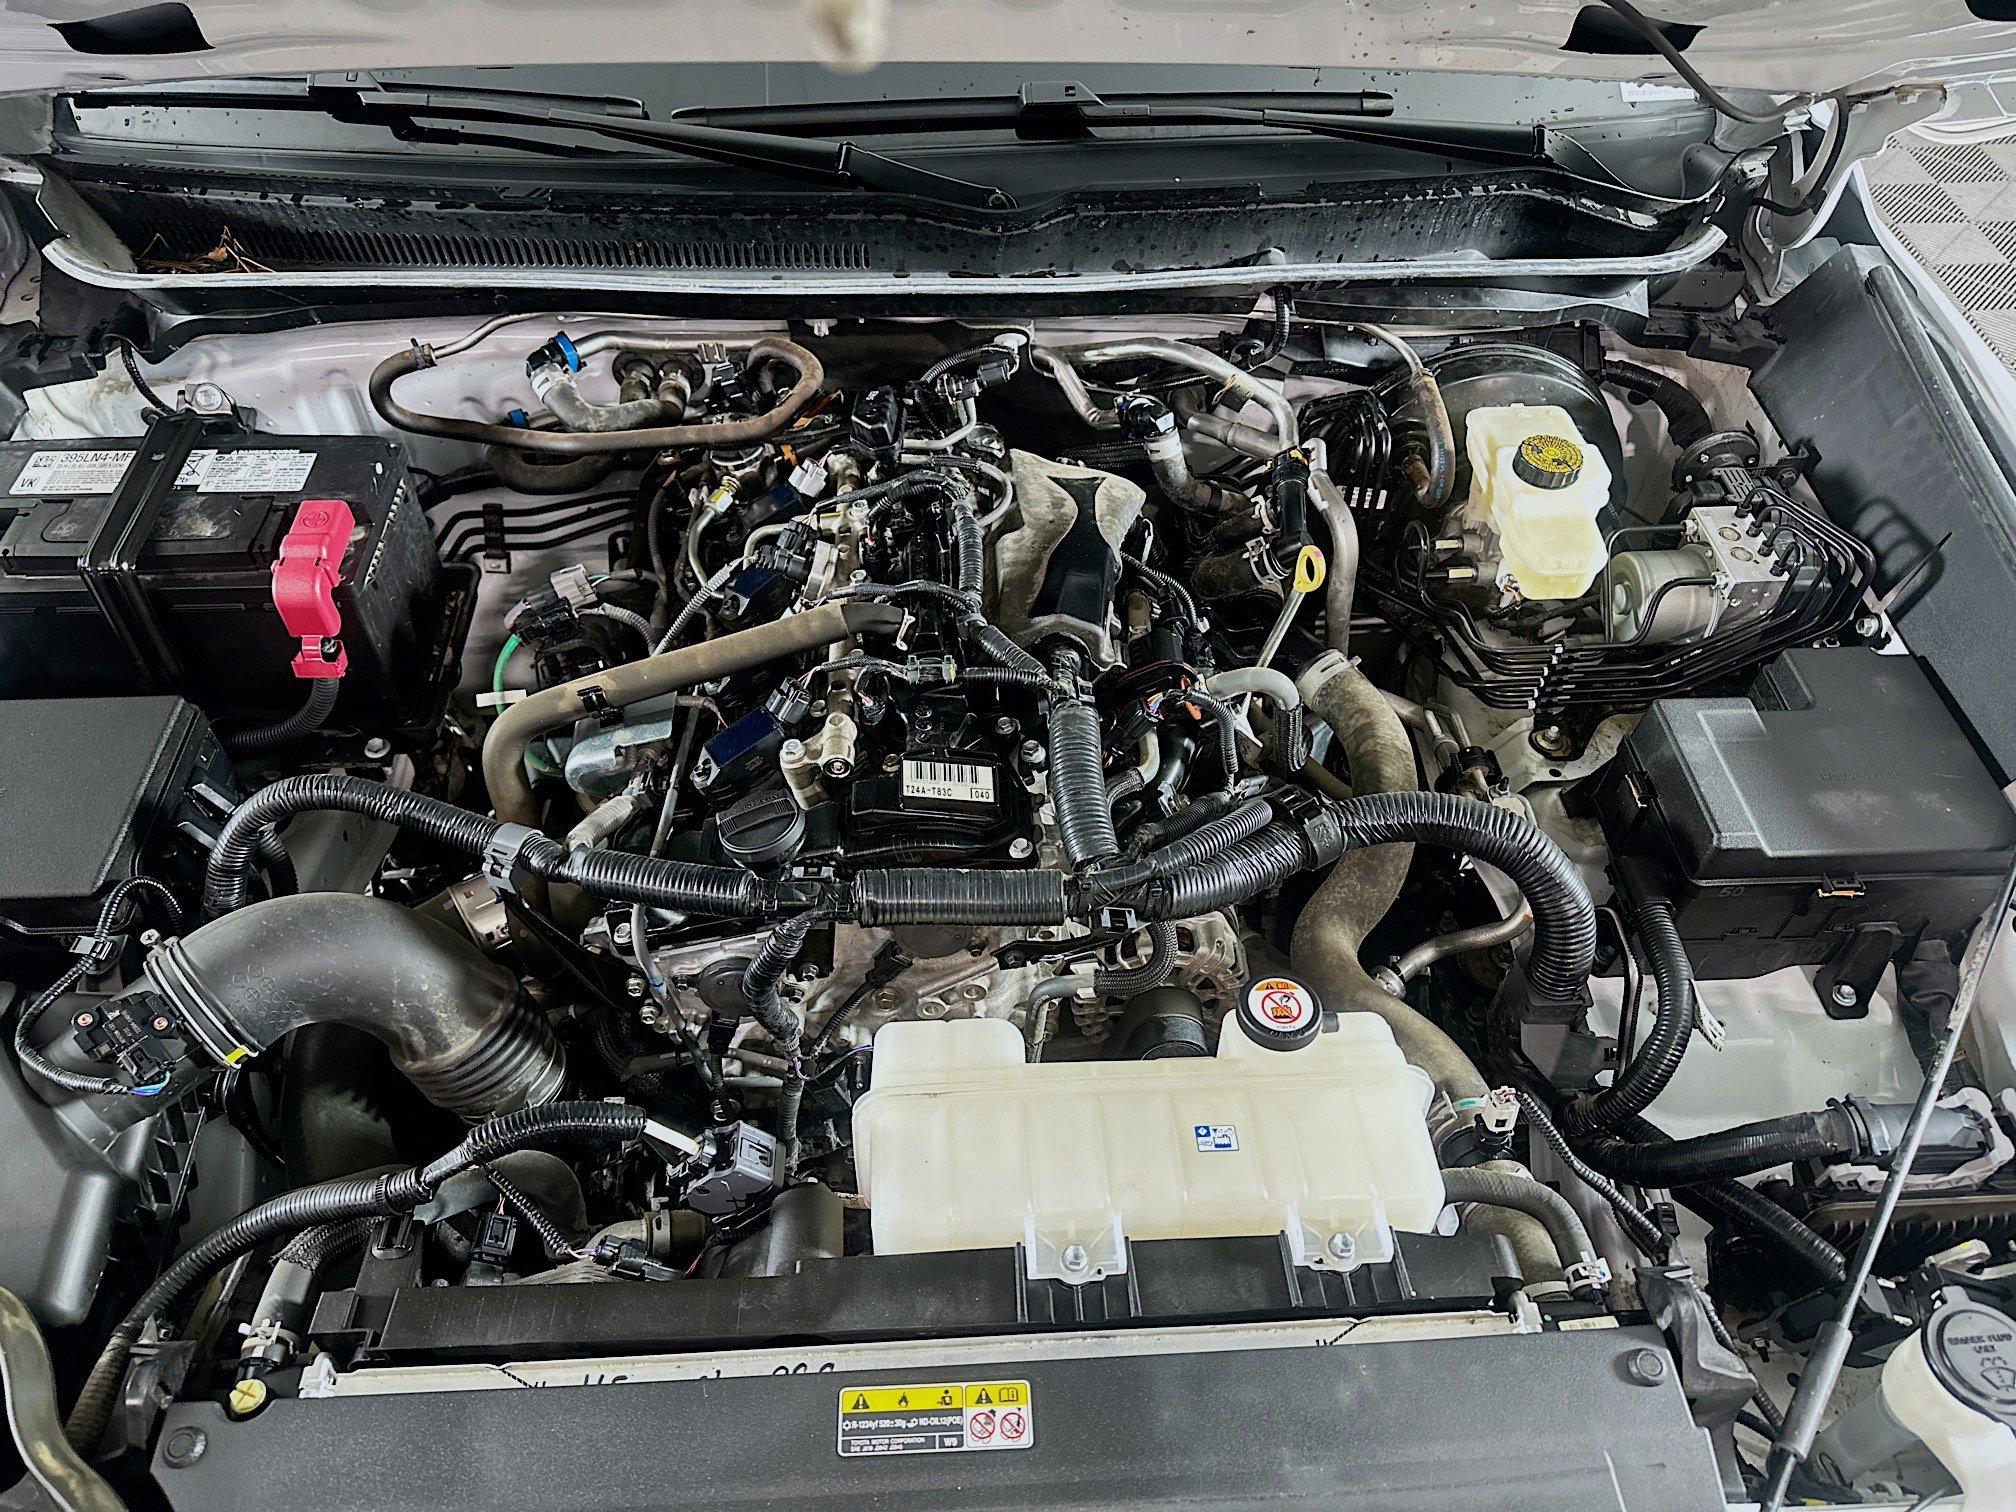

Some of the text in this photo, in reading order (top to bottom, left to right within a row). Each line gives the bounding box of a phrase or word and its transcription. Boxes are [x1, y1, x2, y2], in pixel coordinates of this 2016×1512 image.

[60, 452, 134, 462] 395LN4-MF
[20, 478, 38, 488] VK
[905, 784, 990, 800] T24A-T83C 040
[1718, 885, 1746, 898] 50
[890, 1437, 926, 1445] CORPORATION
[943, 1437, 958, 1447] W9
